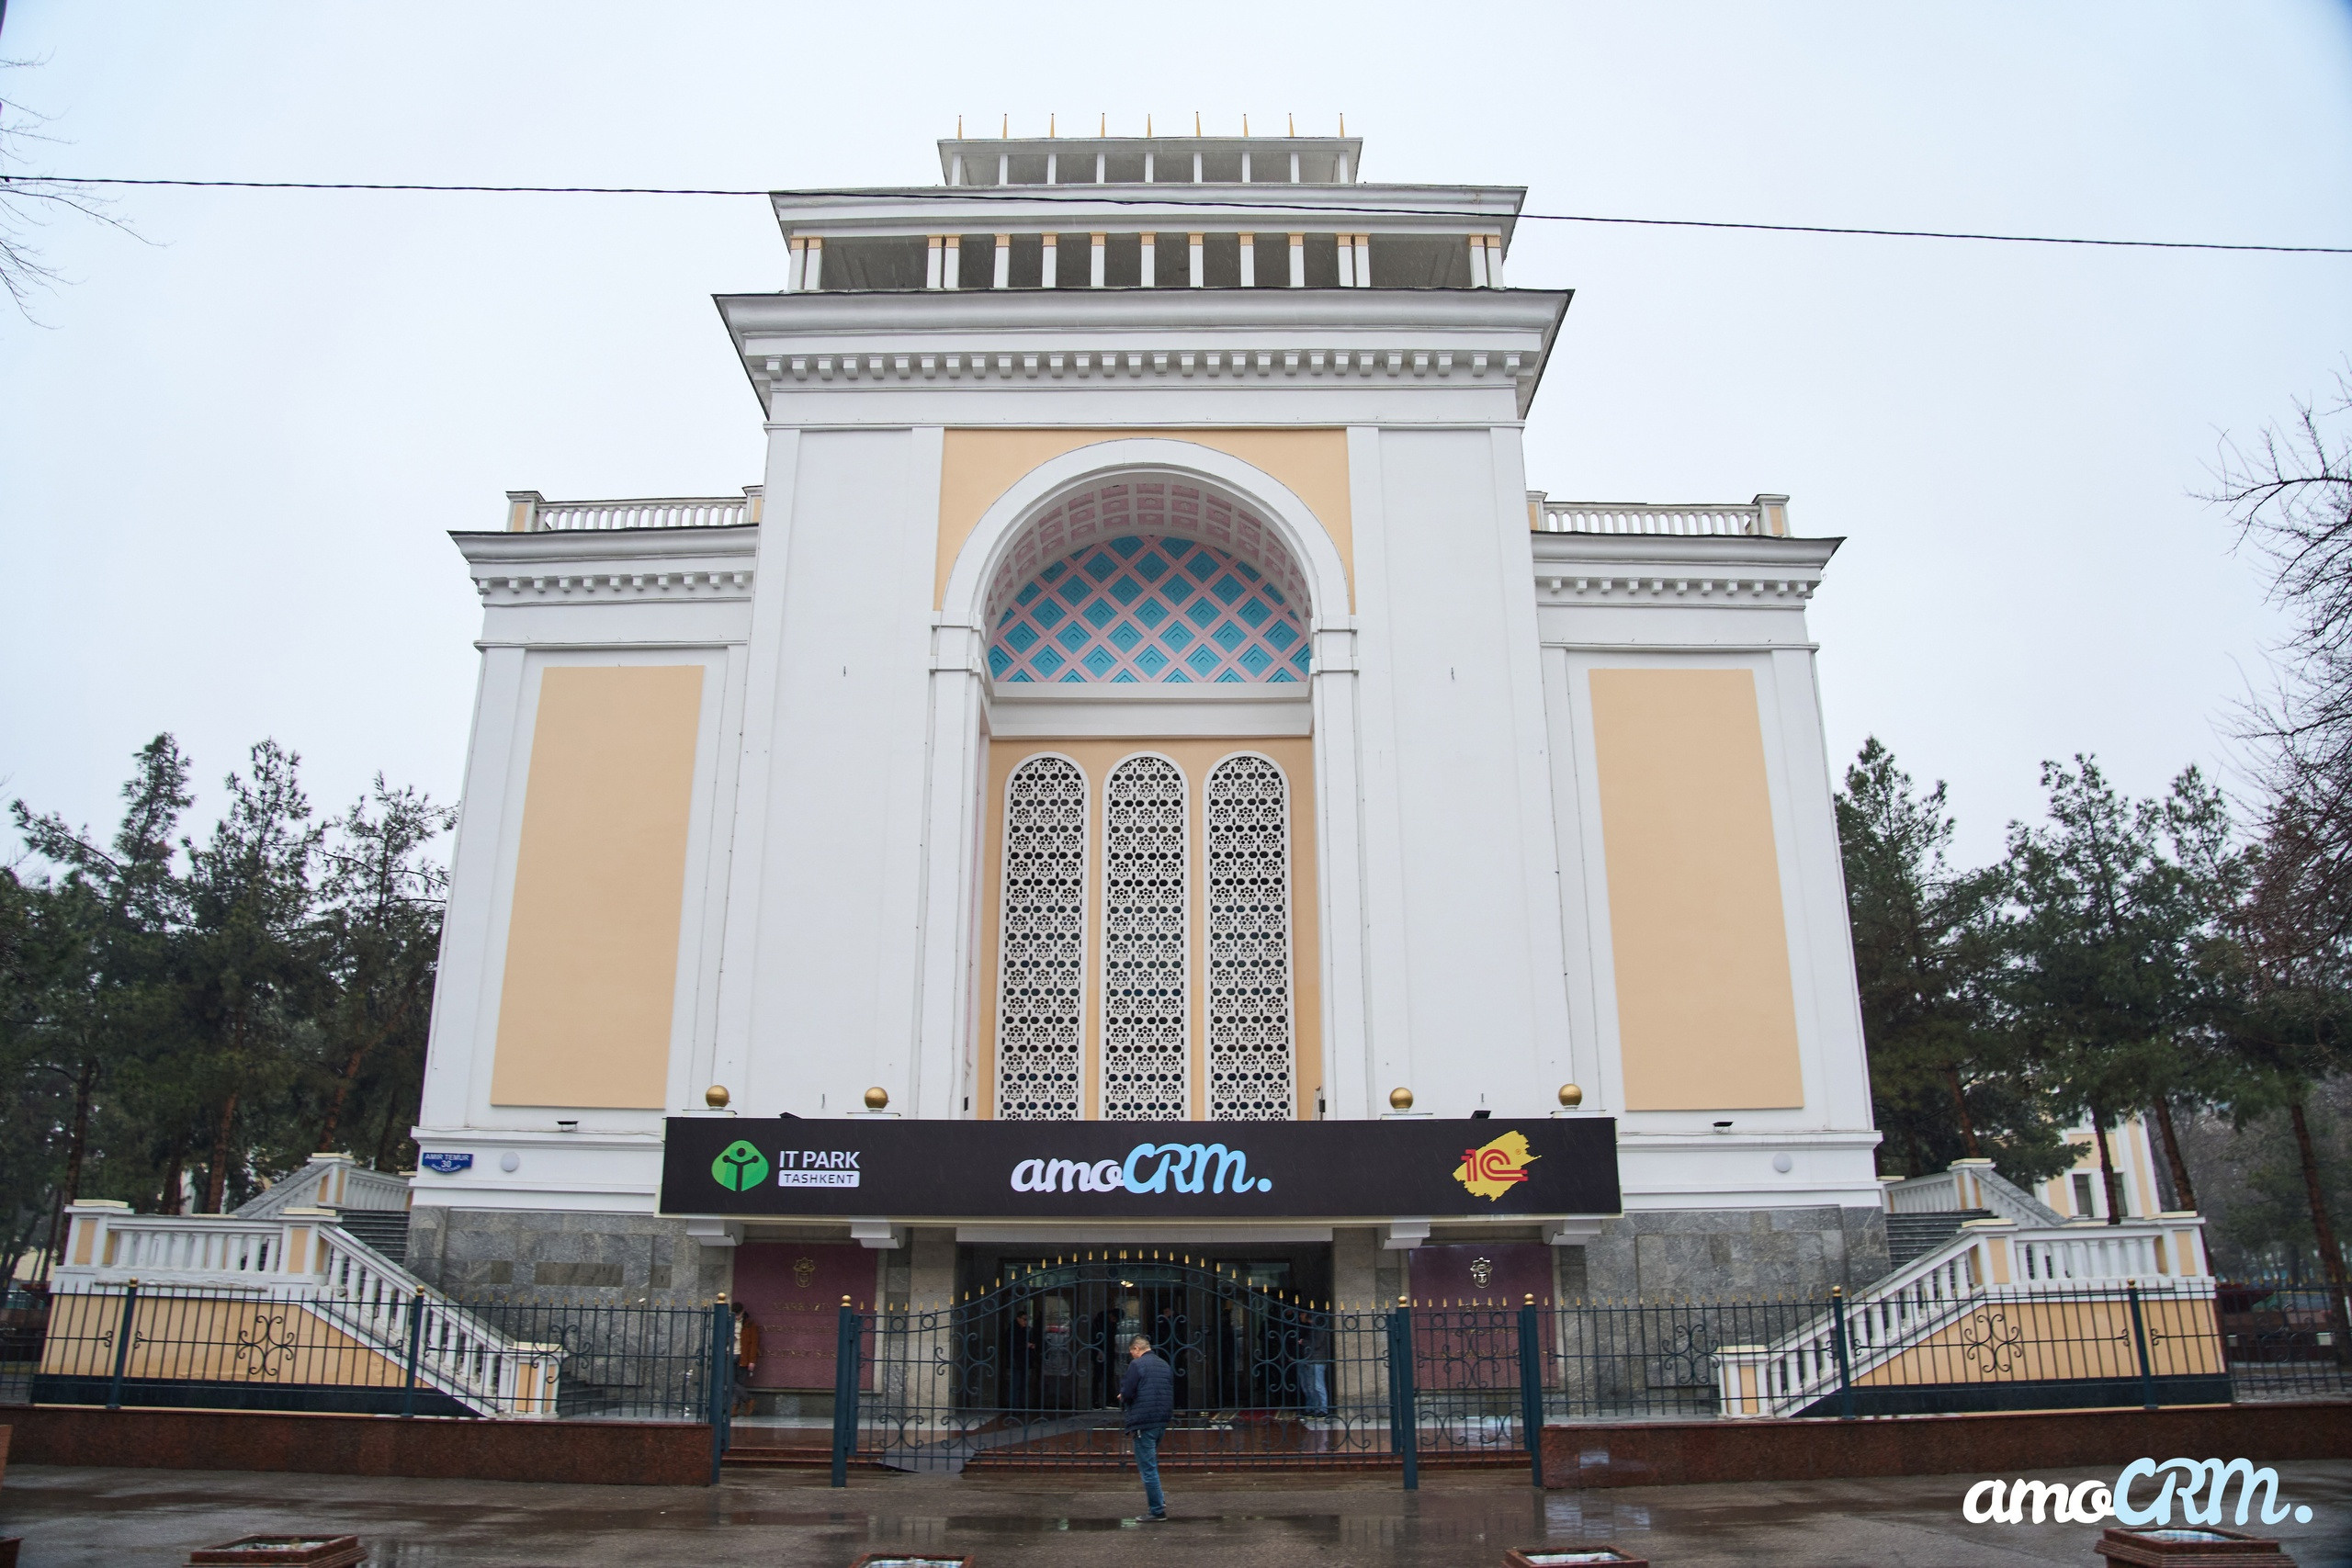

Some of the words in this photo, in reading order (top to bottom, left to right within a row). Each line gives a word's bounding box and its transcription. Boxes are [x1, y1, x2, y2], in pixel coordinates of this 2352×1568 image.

[779, 1151, 799, 1168] IT
[802, 1151, 861, 1169] PARK
[784, 1173, 854, 1184] TASHKENT
